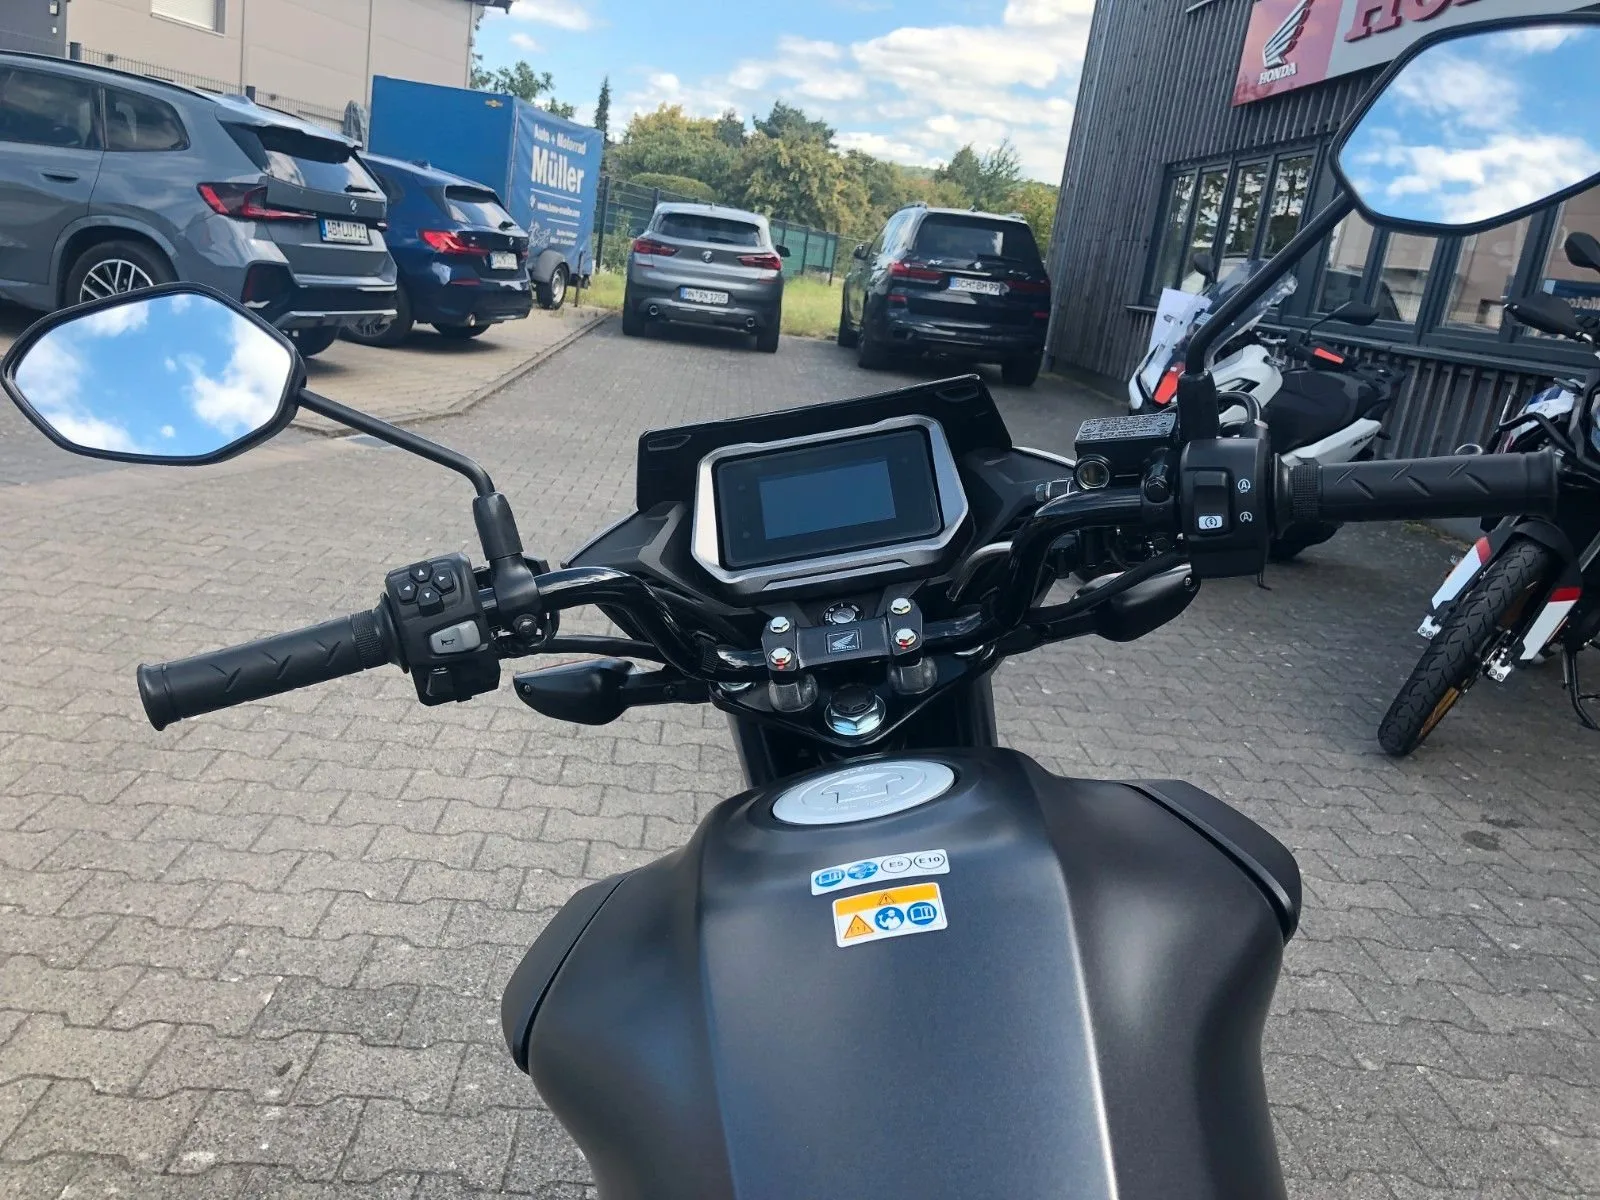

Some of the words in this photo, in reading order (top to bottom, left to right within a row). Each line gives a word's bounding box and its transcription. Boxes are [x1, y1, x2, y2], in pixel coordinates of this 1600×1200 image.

[1258, 62, 1297, 86] HONDA
[534, 123, 550, 143] Auto
[556, 132, 587, 156] Motorrad
[531, 145, 585, 194] Müller
[918, 856, 940, 864] E10
